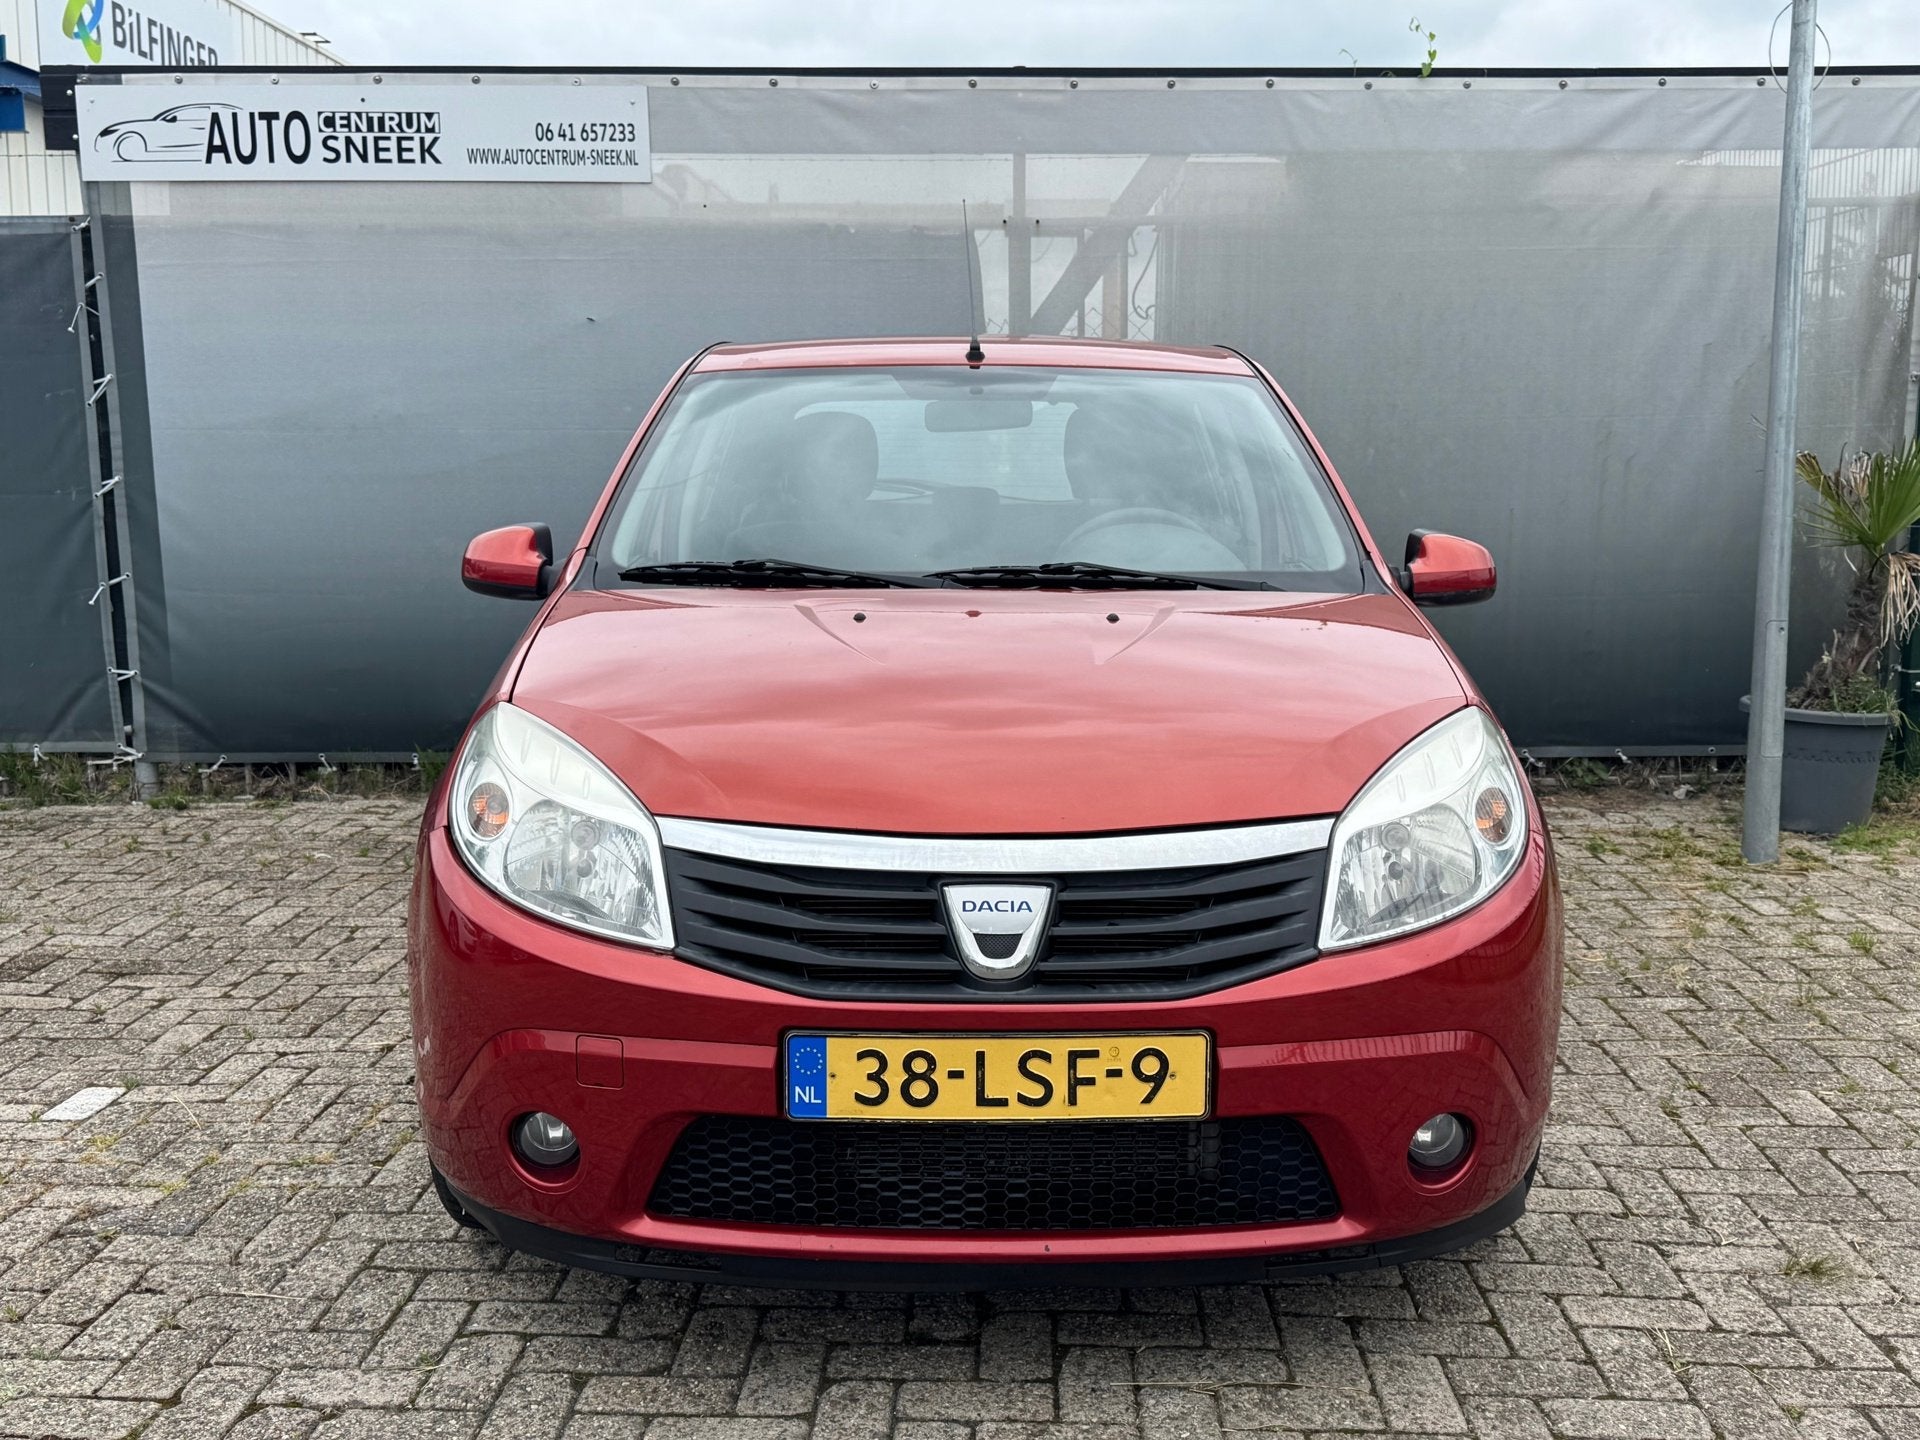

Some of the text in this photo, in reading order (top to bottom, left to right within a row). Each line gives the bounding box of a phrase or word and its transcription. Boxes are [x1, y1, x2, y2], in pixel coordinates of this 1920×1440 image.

[318, 112, 440, 133] CENTRUM
[535, 122, 636, 142] 06 41 657233
[205, 110, 311, 165] AUTO
[321, 135, 443, 165] SNEEK
[466, 147, 639, 166] WWW.AUTOCENTRUM-SNEEK.NL
[961, 900, 1033, 913] DACIA
[853, 1047, 1170, 1107] 38-LSF-9
[794, 1086, 822, 1104] NL
